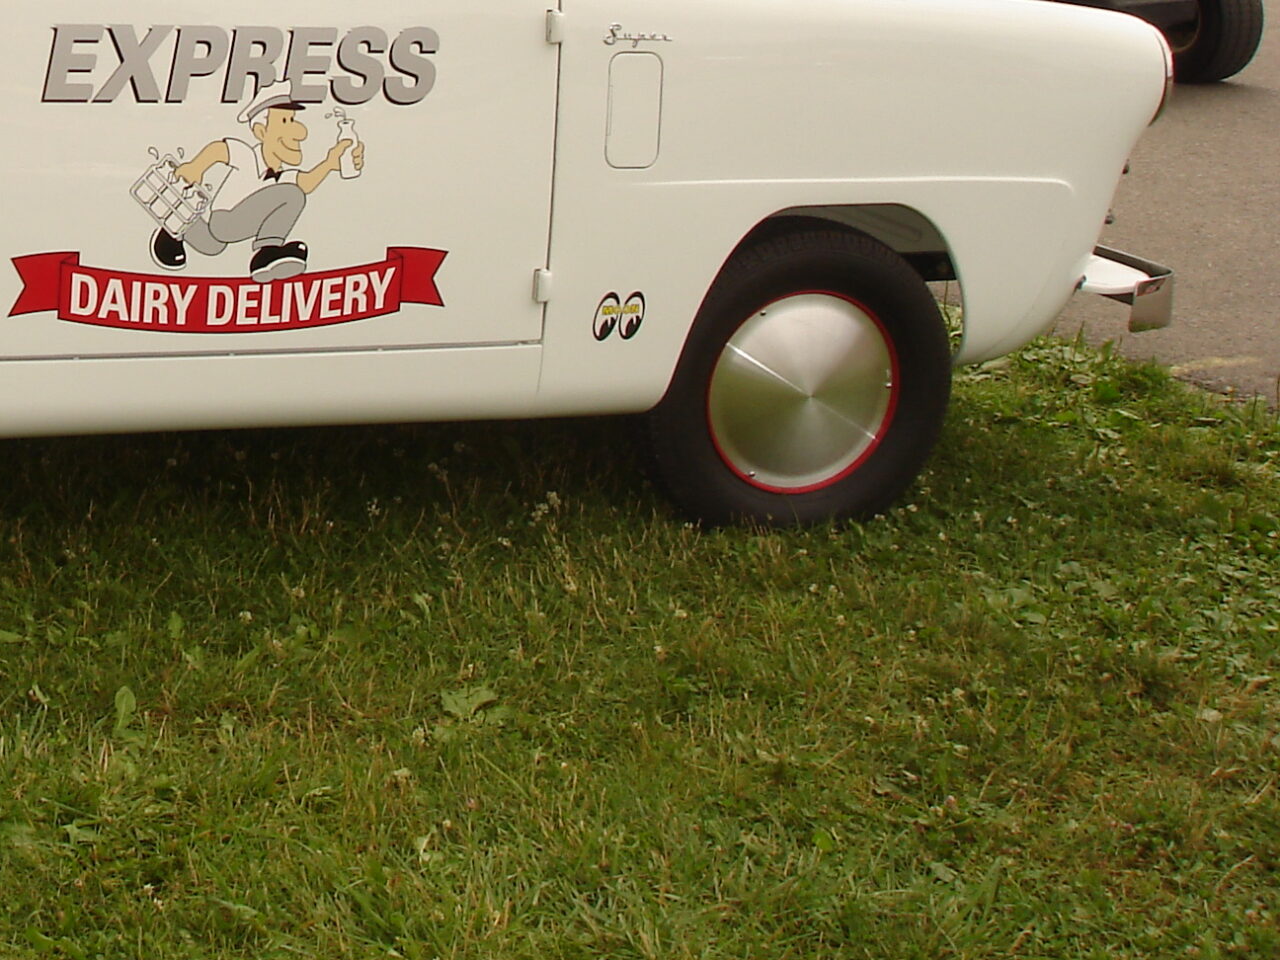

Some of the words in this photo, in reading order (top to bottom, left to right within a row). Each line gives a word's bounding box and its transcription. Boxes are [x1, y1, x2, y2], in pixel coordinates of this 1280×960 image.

[40, 24, 441, 106] EXPRESS
[603, 23, 673, 48] Super
[69, 272, 198, 326] DAIRY
[206, 266, 396, 326] DELIVERY
